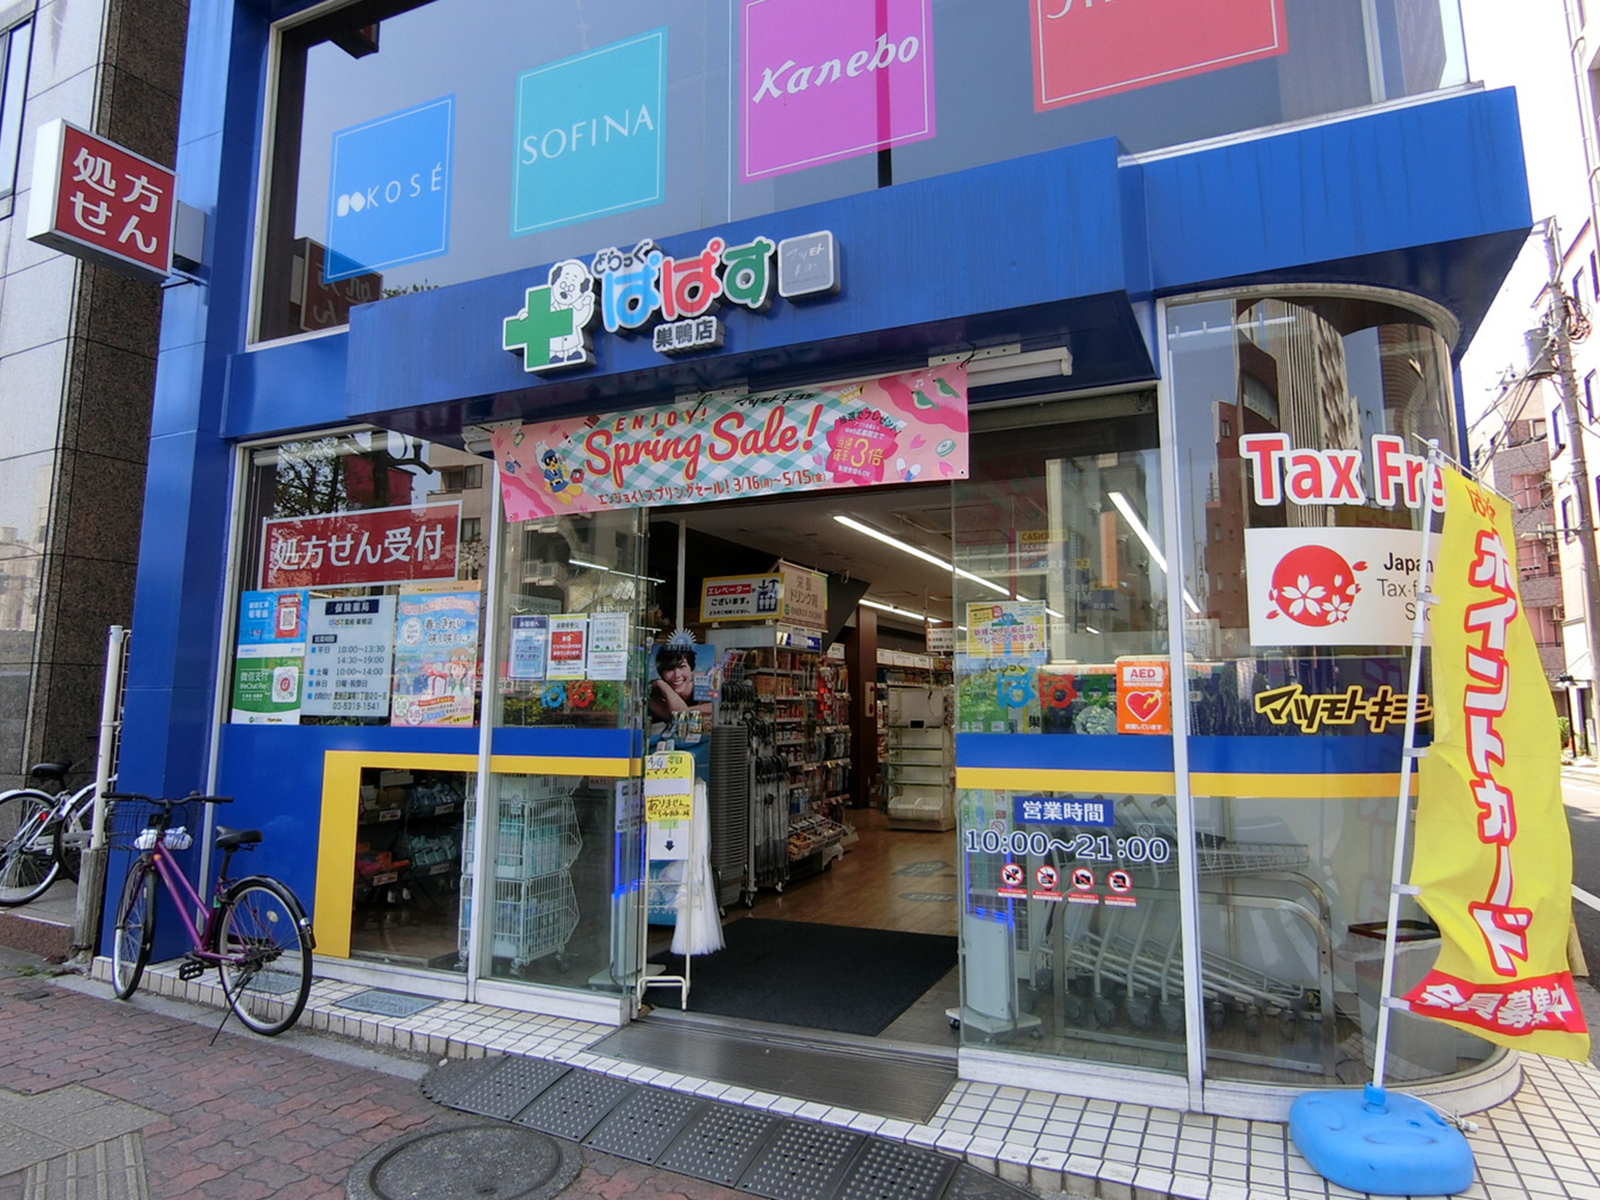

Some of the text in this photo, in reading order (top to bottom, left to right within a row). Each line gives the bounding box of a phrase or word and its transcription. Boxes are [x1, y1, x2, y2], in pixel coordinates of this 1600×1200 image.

[752, 34, 920, 104] Kanebo
[522, 104, 655, 165] SOFINA
[72, 147, 164, 214] 処方
[367, 162, 443, 210] KOSÉ
[69, 192, 157, 255] せん
[593, 240, 652, 276] どらっぐ
[603, 238, 772, 331] ぱぱす
[656, 320, 714, 348] 巣鴨店
[614, 406, 709, 433] ENJOY!
[584, 403, 824, 488] Spring Sale!
[1243, 436, 1363, 502] Tax
[1374, 438, 1444, 506] Fre
[275, 524, 446, 571] 処方せん受付
[1384, 552, 1434, 575] Japan
[1376, 578, 1432, 599] Tax-fe
[318, 645, 385, 654] 平日 10:00～13:30
[337, 656, 385, 664] 14:30～19:00
[315, 680, 328, 688] 休日
[316, 668, 384, 676] 土曜 10:00～14:00
[1130, 668, 1156, 678] AED
[1023, 801, 1104, 822] 営業時間
[966, 829, 1170, 863] 10:00～21:00
